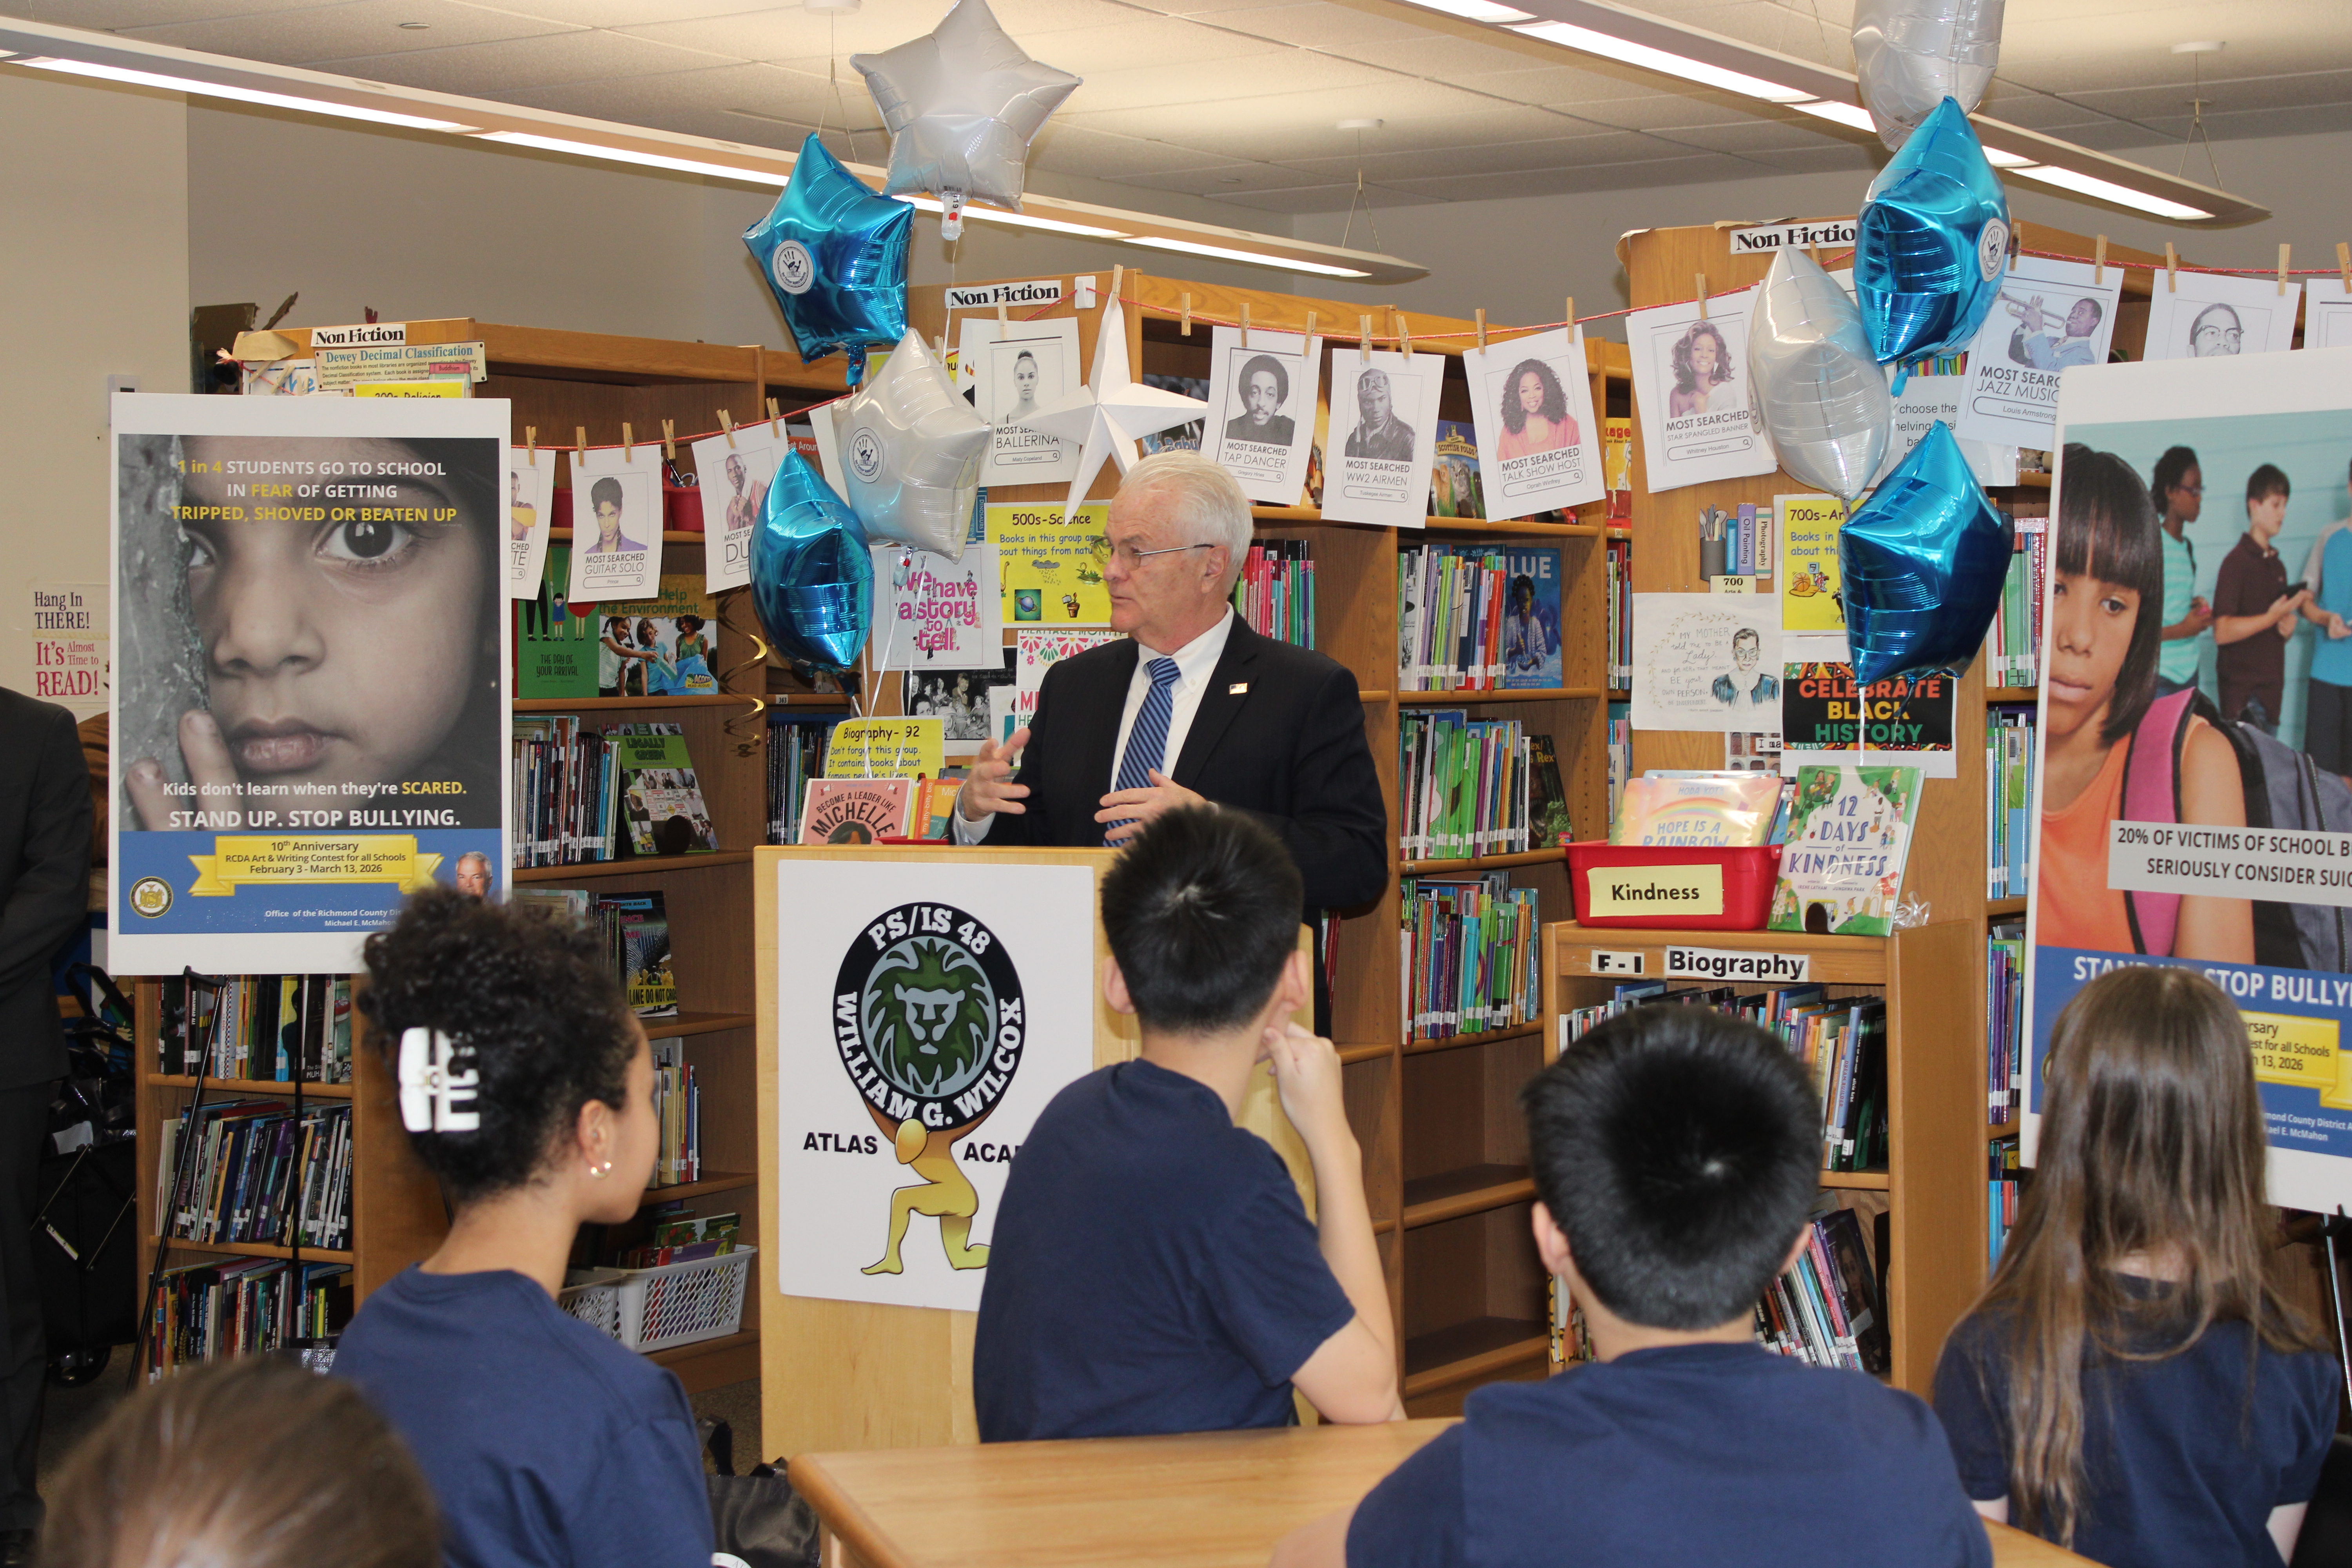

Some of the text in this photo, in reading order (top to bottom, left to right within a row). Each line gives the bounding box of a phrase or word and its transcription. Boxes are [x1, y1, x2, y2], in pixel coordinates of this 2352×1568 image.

[951, 291, 989, 306] Non
[316, 327, 404, 344] Non Fiction
[326, 345, 472, 364] Dewey Decimal Classification
[1980, 366, 2018, 381] MOST
[1977, 379, 2011, 395] JAZZ
[1667, 411, 1748, 431] MOST SEARCHED
[2003, 406, 2056, 421] Louis Armstrong
[1685, 428, 1720, 439] SPANGLED
[1722, 423, 1748, 433] BANNER
[997, 435, 1060, 448] BALLERINA
[1227, 442, 1287, 456] MOST SEARCHED
[1225, 452, 1286, 468] TAP DANCER
[1346, 460, 1410, 472] MOST SEARCHED
[1503, 447, 1579, 471] MOST SEARCHED
[177, 460, 446, 475] 1 in 4 STUDENTS GO TO SCHOOL
[1503, 458, 1580, 481] TALK SHOW HOST
[1347, 472, 1407, 486] WW2 AIRMEN
[228, 484, 397, 498] IN FEAR OF GETTING
[172, 506, 456, 522] TRIPPED, SHOVED OR BEATEN UP
[1000, 534, 1025, 543] Books
[1040, 533, 1055, 542] this
[1059, 535, 1082, 544] group
[1759, 521, 1768, 566] Photography
[1741, 534, 1749, 564] Painting
[608, 553, 644, 562] SEARCHED
[585, 562, 644, 574] GUITAR SOLO
[34, 592, 82, 611] Hang In
[35, 612, 89, 629] THERE!
[1697, 627, 1730, 638] MOTHER
[36, 641, 94, 665] It's Almost
[67, 655, 98, 665] Time to
[541, 654, 573, 664] THE DAY OF
[537, 666, 578, 677] YOUR ARRIVAL
[36, 670, 98, 697] READ!
[1816, 723, 1923, 742] HISTORY
[626, 738, 665, 748] LEGALLY
[635, 750, 666, 760] GREEN
[163, 782, 466, 798] Kids don't learn when they're SCARED.
[817, 794, 845, 816] BECOME
[855, 791, 881, 803] LEADER
[880, 799, 896, 813] LIKE
[923, 795, 932, 820] itty-bitty
[1838, 796, 1858, 816] 12
[169, 809, 460, 828] STAND UP. STOP BULLYING.
[811, 801, 896, 837] MICHELLE
[922, 822, 928, 832] my
[1820, 821, 1869, 842] DAYS
[292, 842, 359, 853] Anniversary
[2118, 828, 2335, 856] 20% OF VICTIMS OF SCHOOL
[276, 854, 309, 864] Writing
[1788, 853, 1887, 876] KINDNESS
[250, 865, 294, 875] February
[310, 864, 341, 873] March
[344, 864, 357, 873] 13,
[2147, 858, 2315, 884] SERIOUSLY CONSIDER
[1612, 883, 1699, 900] Kindness
[868, 906, 990, 954] PS/IS 48
[1669, 950, 1805, 980] Biography
[629, 988, 665, 1005] LINE DO NOT
[837, 991, 1021, 1126] WILLIAM G. WILCOX
[803, 1132, 877, 1154] ATLAS
